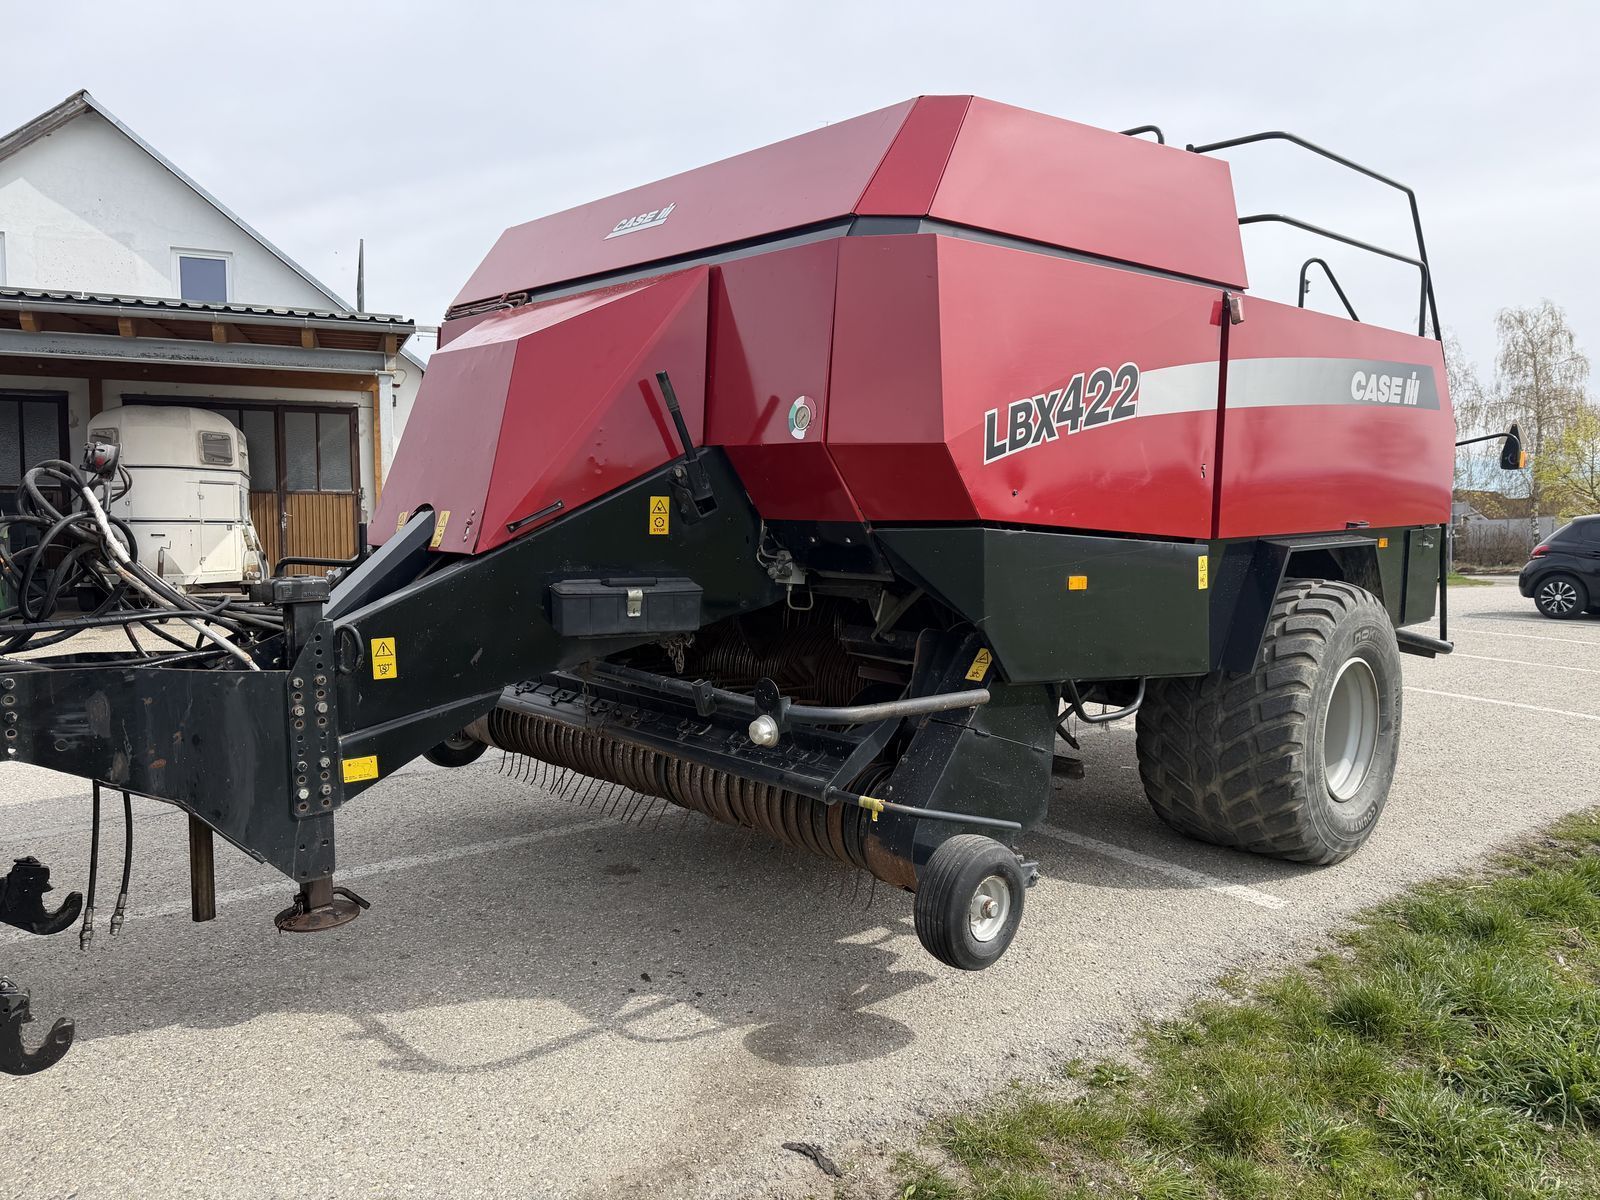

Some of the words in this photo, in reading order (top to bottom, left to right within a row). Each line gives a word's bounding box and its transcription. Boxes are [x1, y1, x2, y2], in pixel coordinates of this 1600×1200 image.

[612, 210, 659, 232] CASE
[1351, 371, 1403, 404] CASE
[984, 362, 1140, 465] LBX422
